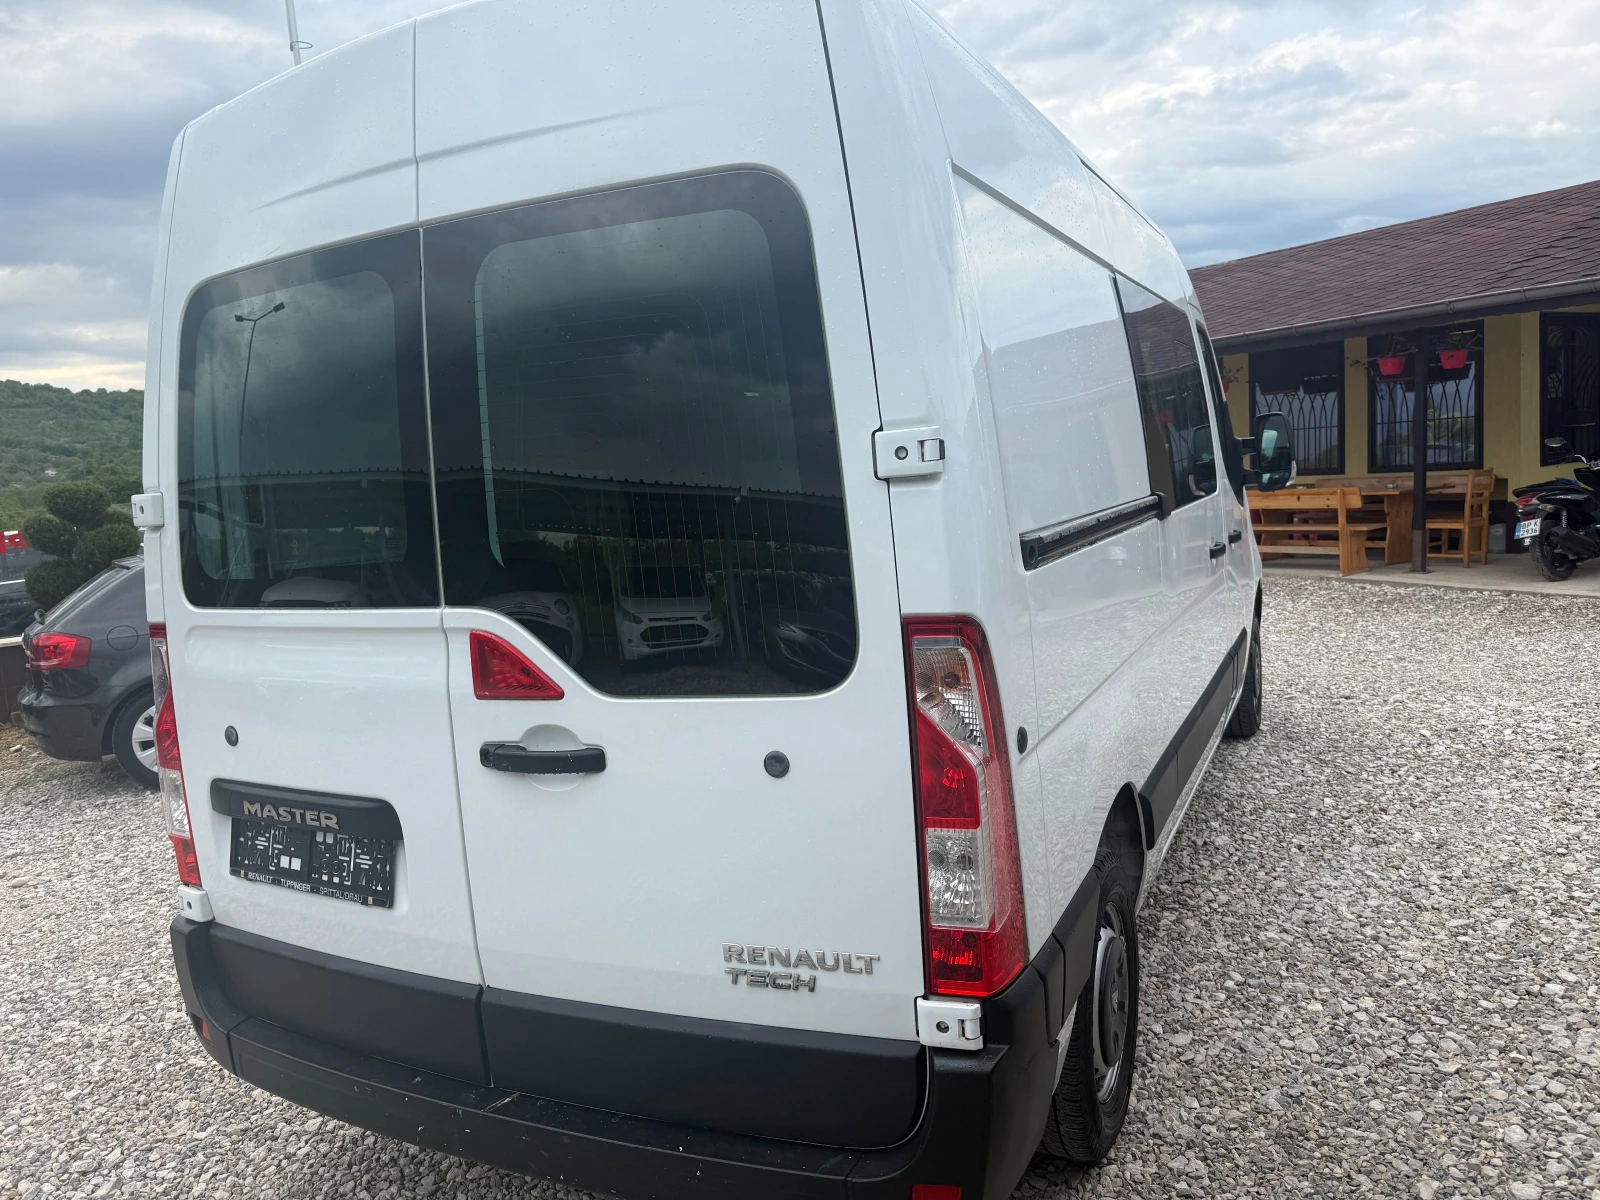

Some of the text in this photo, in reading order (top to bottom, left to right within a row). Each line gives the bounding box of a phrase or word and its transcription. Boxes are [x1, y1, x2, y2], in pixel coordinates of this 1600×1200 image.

[243, 800, 339, 830] MASTER
[247, 872, 273, 884] RENAULT
[721, 942, 881, 975] RENAULT
[724, 967, 817, 993] TECH
